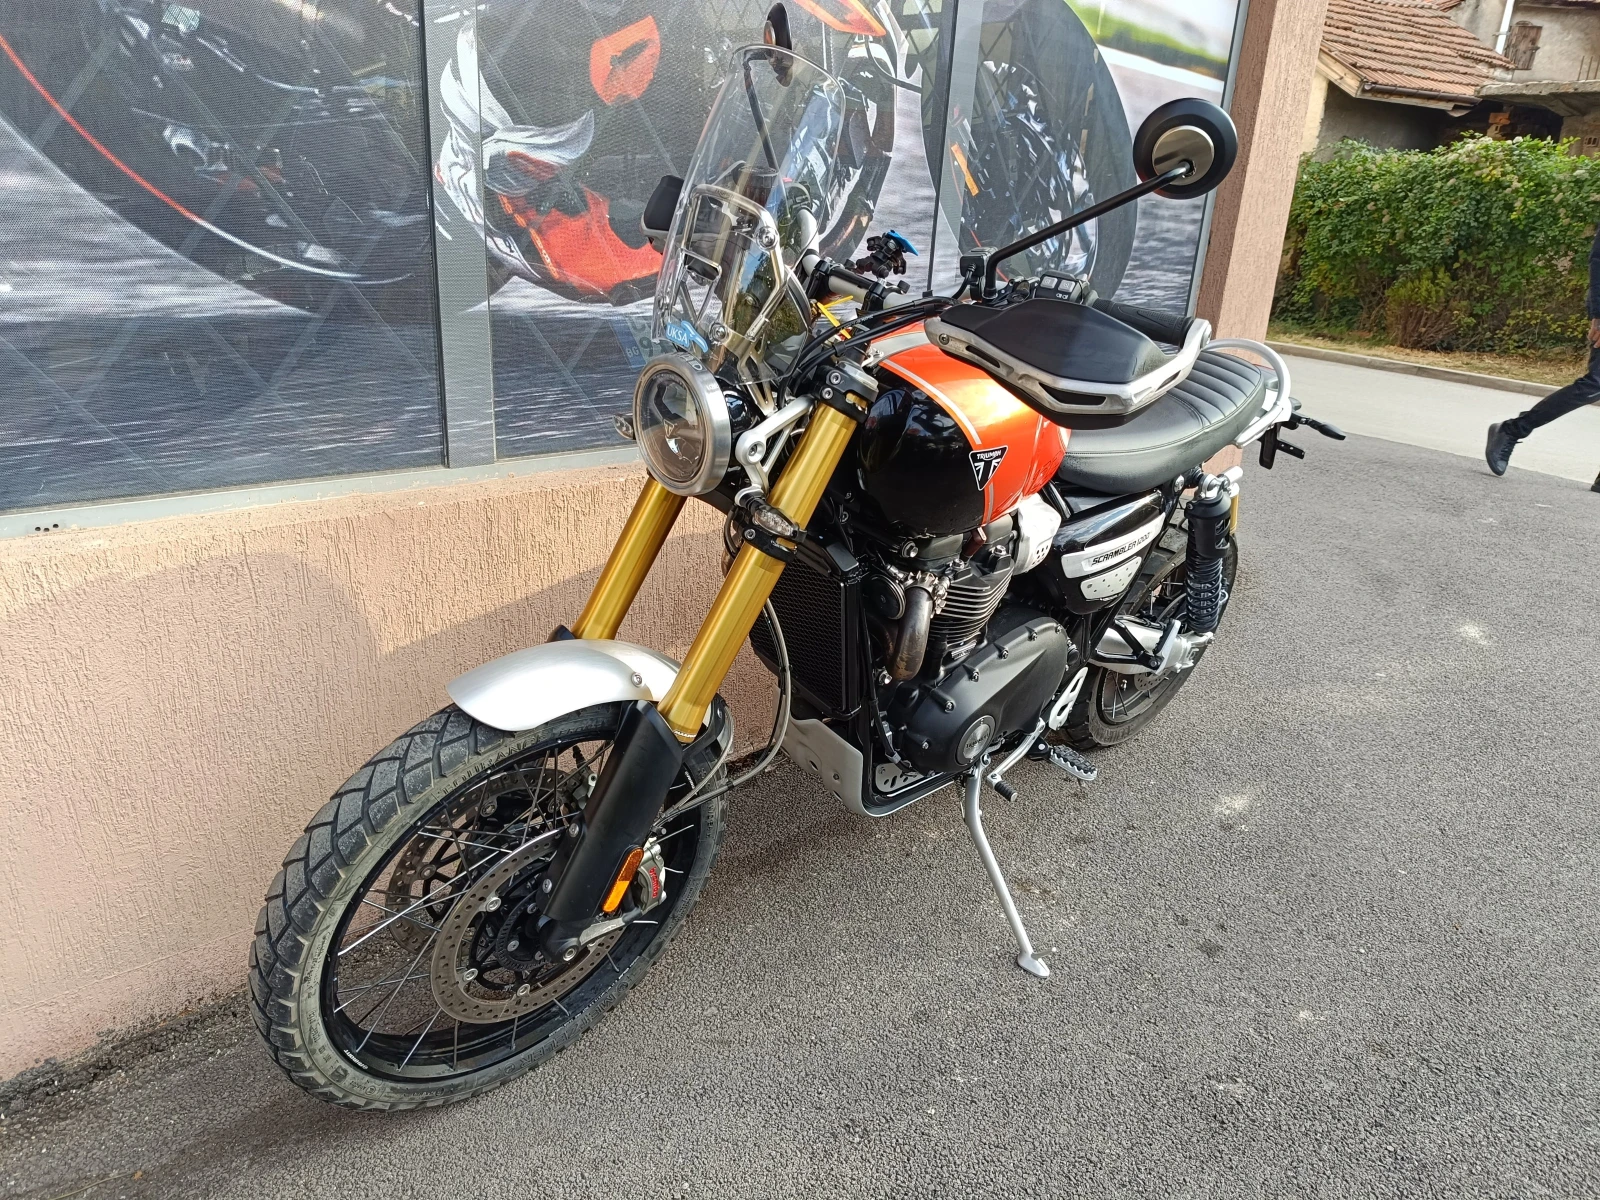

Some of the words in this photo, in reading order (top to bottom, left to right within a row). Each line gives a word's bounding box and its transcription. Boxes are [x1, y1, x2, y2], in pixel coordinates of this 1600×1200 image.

[976, 449, 1001, 461] TRIUMPH
[1091, 540, 1137, 566] SCRAMBLER
[1136, 531, 1151, 547] 1200
